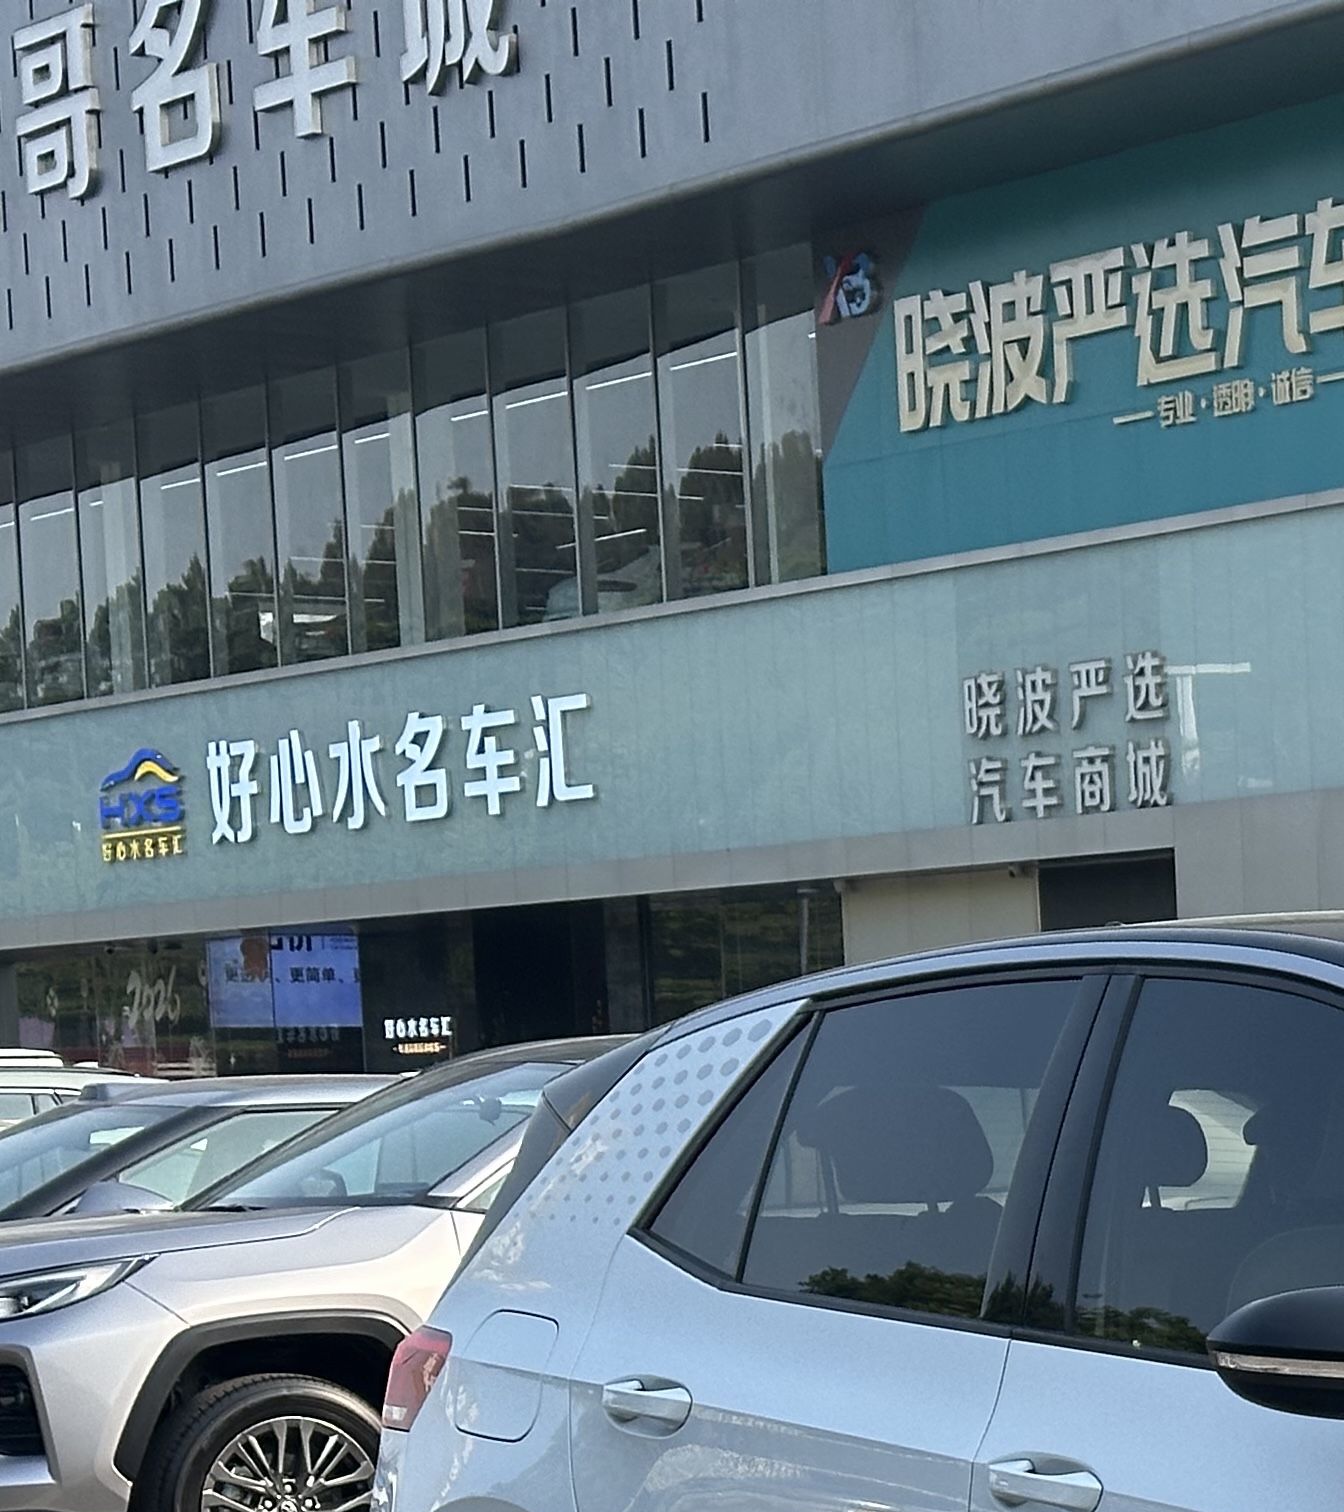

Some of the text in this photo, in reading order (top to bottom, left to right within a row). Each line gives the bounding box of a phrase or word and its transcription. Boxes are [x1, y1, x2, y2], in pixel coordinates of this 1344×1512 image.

[962, 650, 1168, 738] 晓波严选
[98, 785, 180, 829] HXS
[207, 693, 595, 845] 好心水名车汇
[968, 739, 1172, 825] 汽车商城
